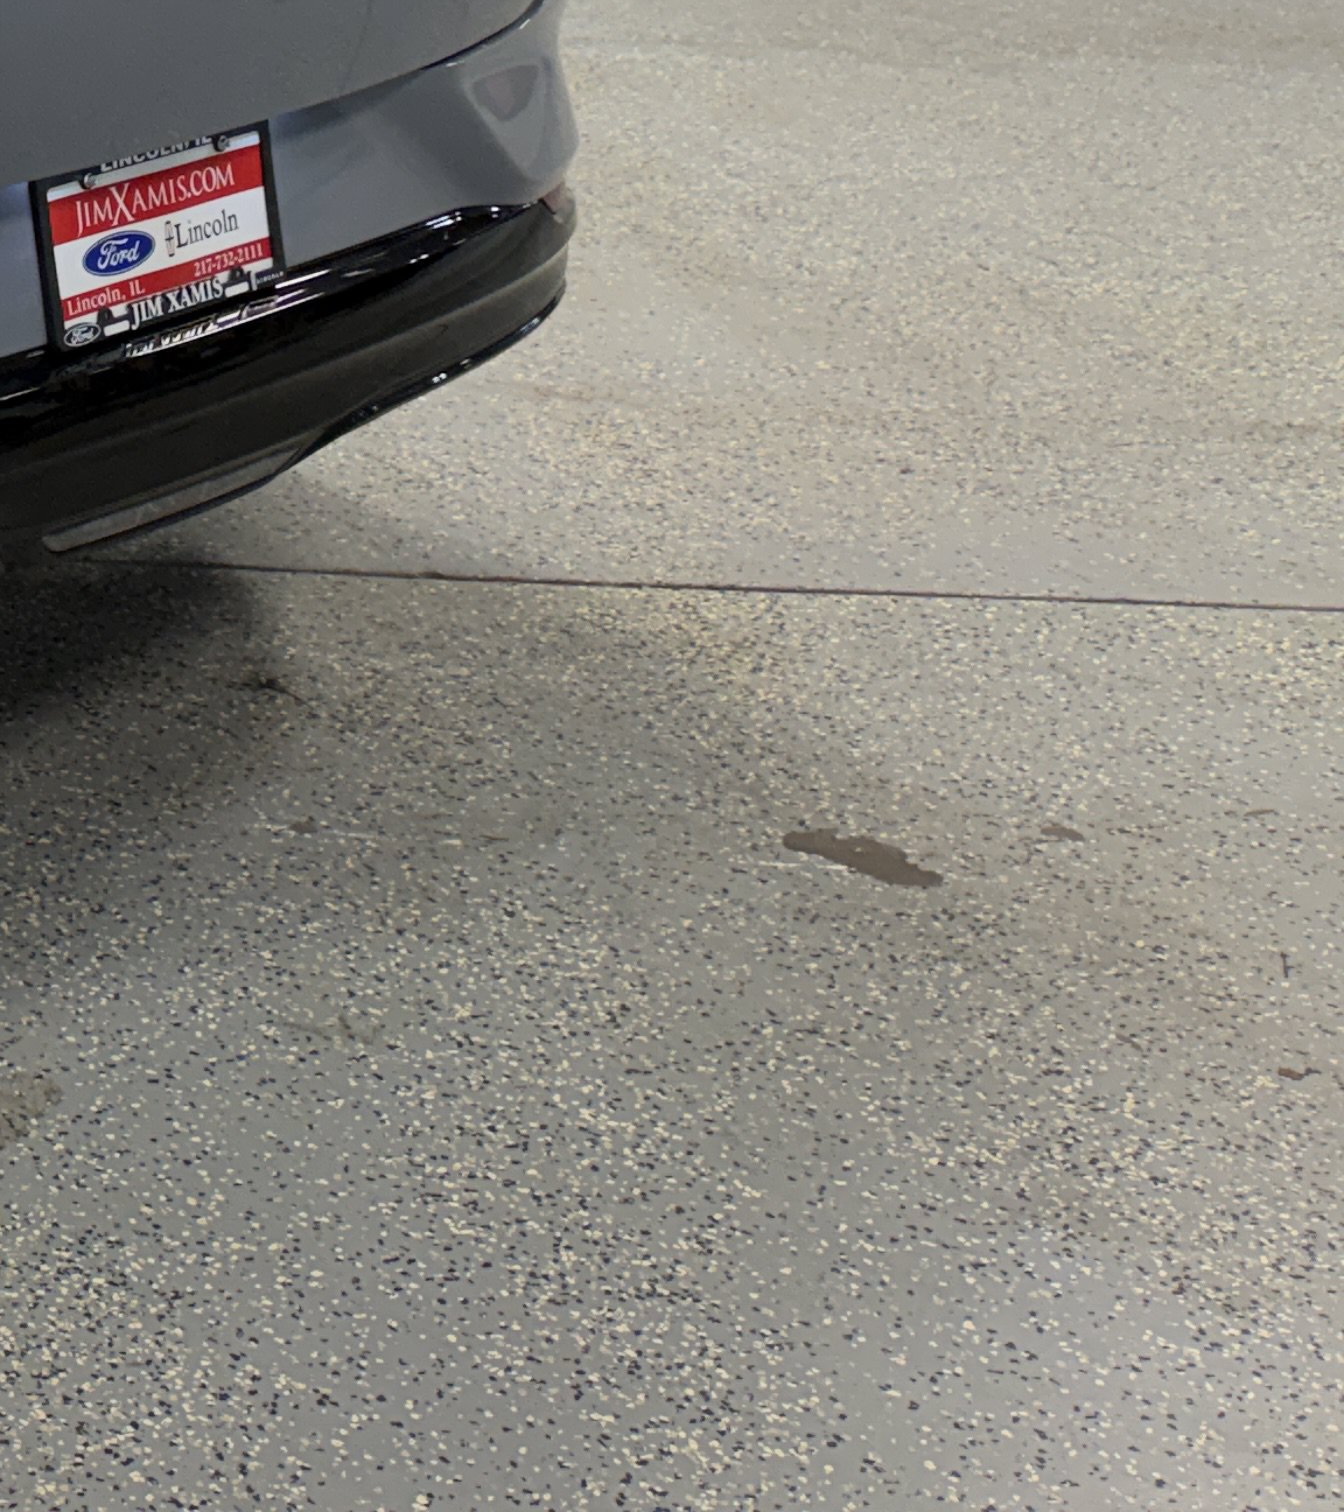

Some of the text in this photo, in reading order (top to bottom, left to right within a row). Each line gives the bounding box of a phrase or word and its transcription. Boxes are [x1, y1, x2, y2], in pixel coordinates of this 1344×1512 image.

[174, 209, 240, 249] Lincoln
[194, 243, 264, 277] 217-732-2111
[129, 279, 146, 296] IL
[131, 297, 164, 331] JIM
[168, 277, 226, 314] XAMIS
